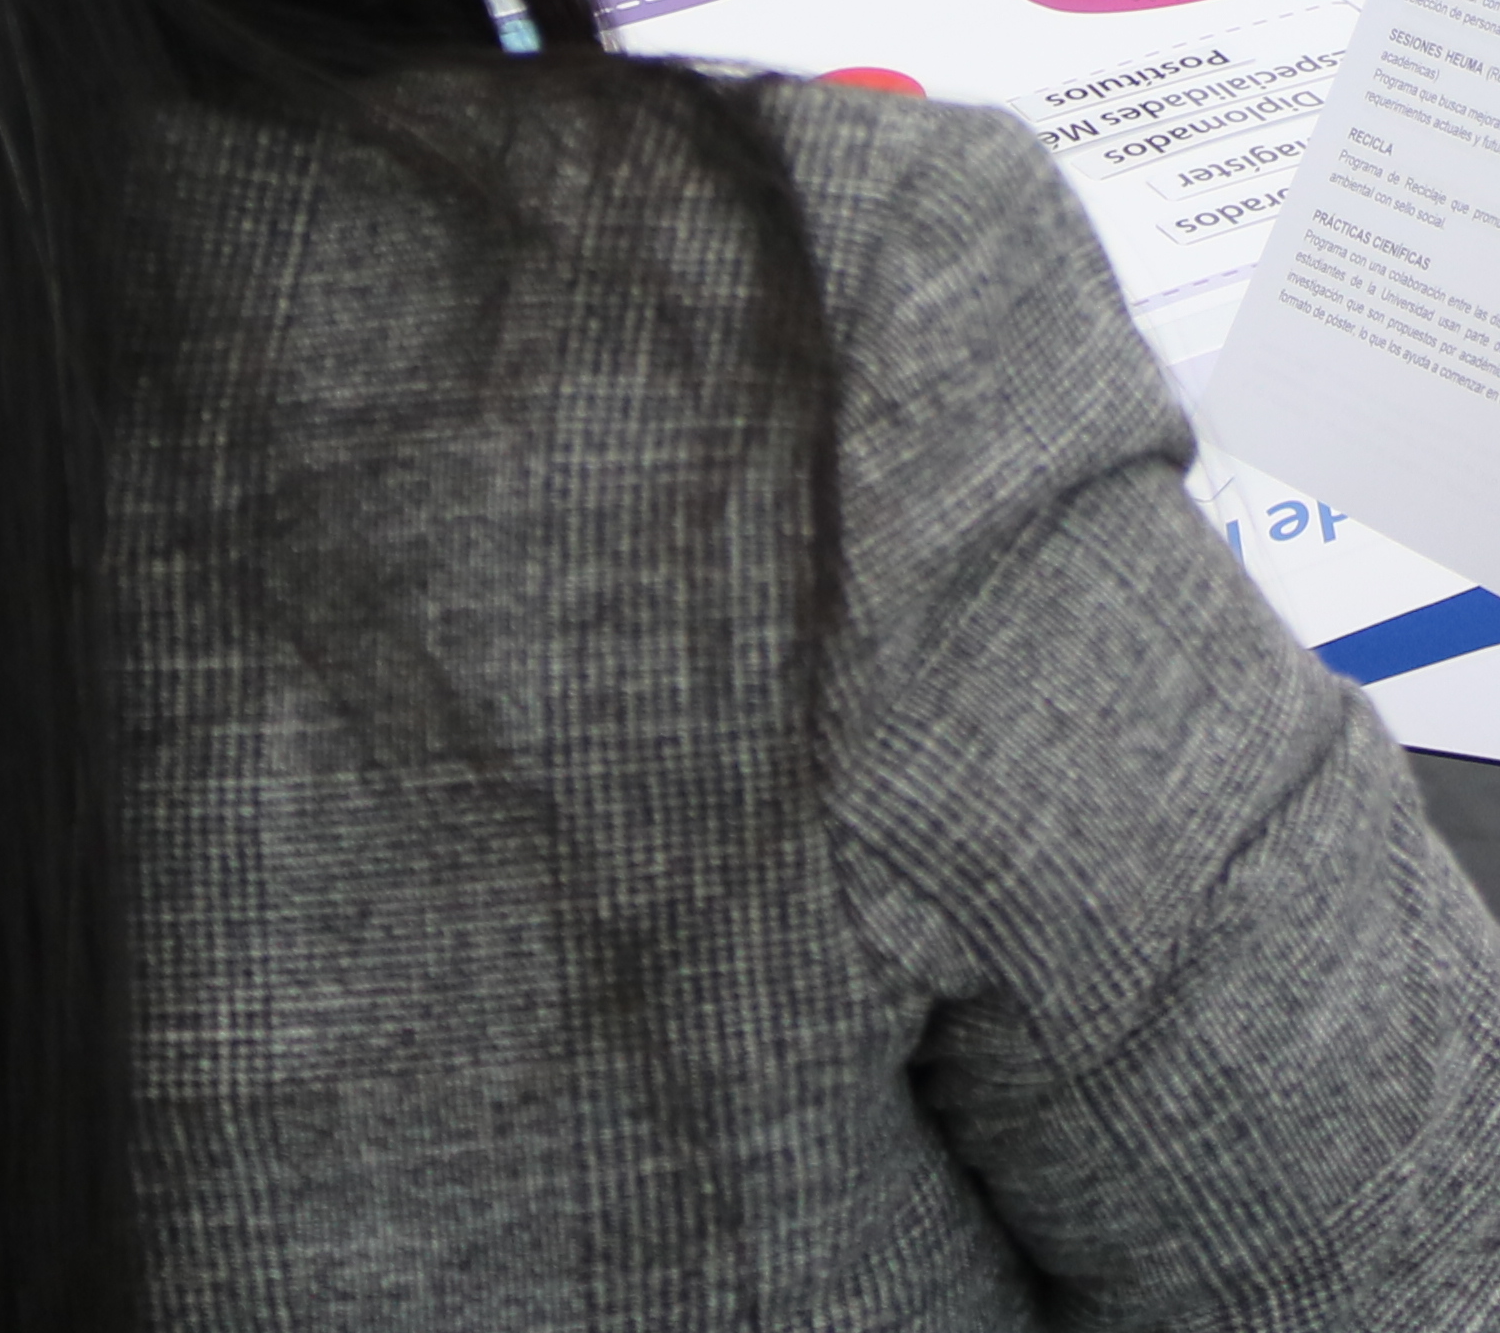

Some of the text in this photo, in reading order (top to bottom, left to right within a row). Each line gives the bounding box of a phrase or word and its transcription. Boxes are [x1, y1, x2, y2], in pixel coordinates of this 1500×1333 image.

[1448, 5, 1462, 20] de
[1380, 50, 1440, 81] académicas)
[1388, 27, 1443, 57] SESIONES
[1444, 49, 1484, 74] HEUMA
[1044, 49, 1231, 107] Postítulos
[1372, 69, 1418, 96] Programa
[1418, 89, 1438, 104] que
[1437, 94, 1467, 115] busca
[1103, 90, 1325, 165] Diplomados
[1347, 129, 1393, 156] RECICLA
[1328, 172, 1375, 197] ambiental
[1373, 191, 1393, 206] con
[1392, 199, 1416, 216] sello
[1312, 208, 1372, 243] PRÁCTICAS
[1303, 228, 1348, 259] Programa
[1348, 251, 1367, 267] con
[1367, 260, 1387, 276] una
[1387, 269, 1446, 301] colaboración
[1446, 295, 1472, 313] entre
[1472, 304, 1488, 321] las
[1278, 289, 1312, 313] formato
[1311, 305, 1326, 319] de
[1357, 325, 1368, 340] lo
[1368, 333, 1387, 349] que
[1386, 339, 1402, 356] los
[1401, 348, 1431, 370] ayuda
[1430, 362, 1439, 373] a
[1438, 366, 1486, 394] comenzar
[1484, 387, 1499, 401] en
